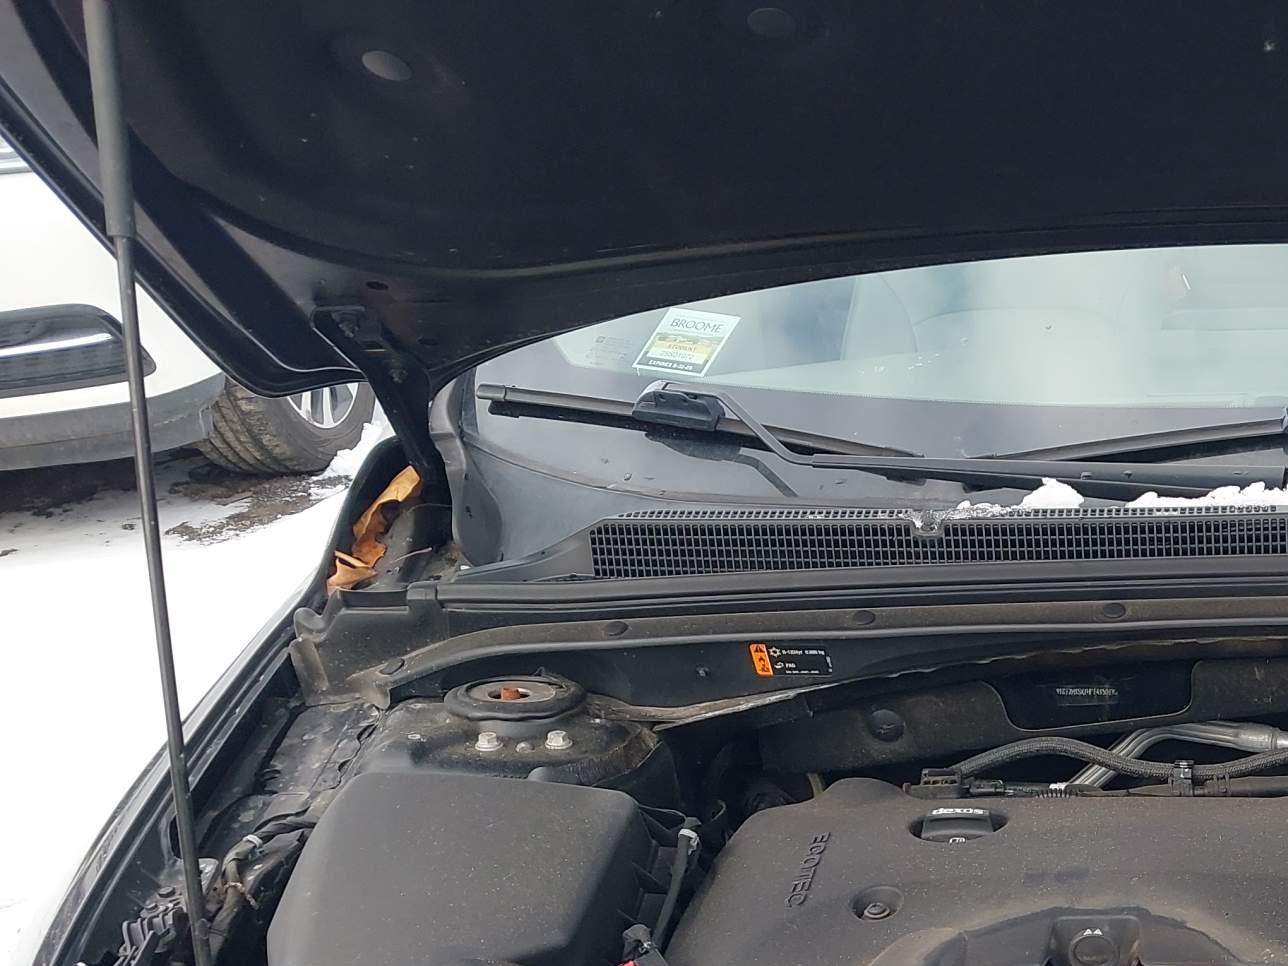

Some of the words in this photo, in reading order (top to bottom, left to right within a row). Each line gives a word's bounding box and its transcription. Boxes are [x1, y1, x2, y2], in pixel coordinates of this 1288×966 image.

[670, 318, 724, 333] BROOME
[931, 807, 984, 815] dexos
[785, 831, 831, 908] ECOTEC
